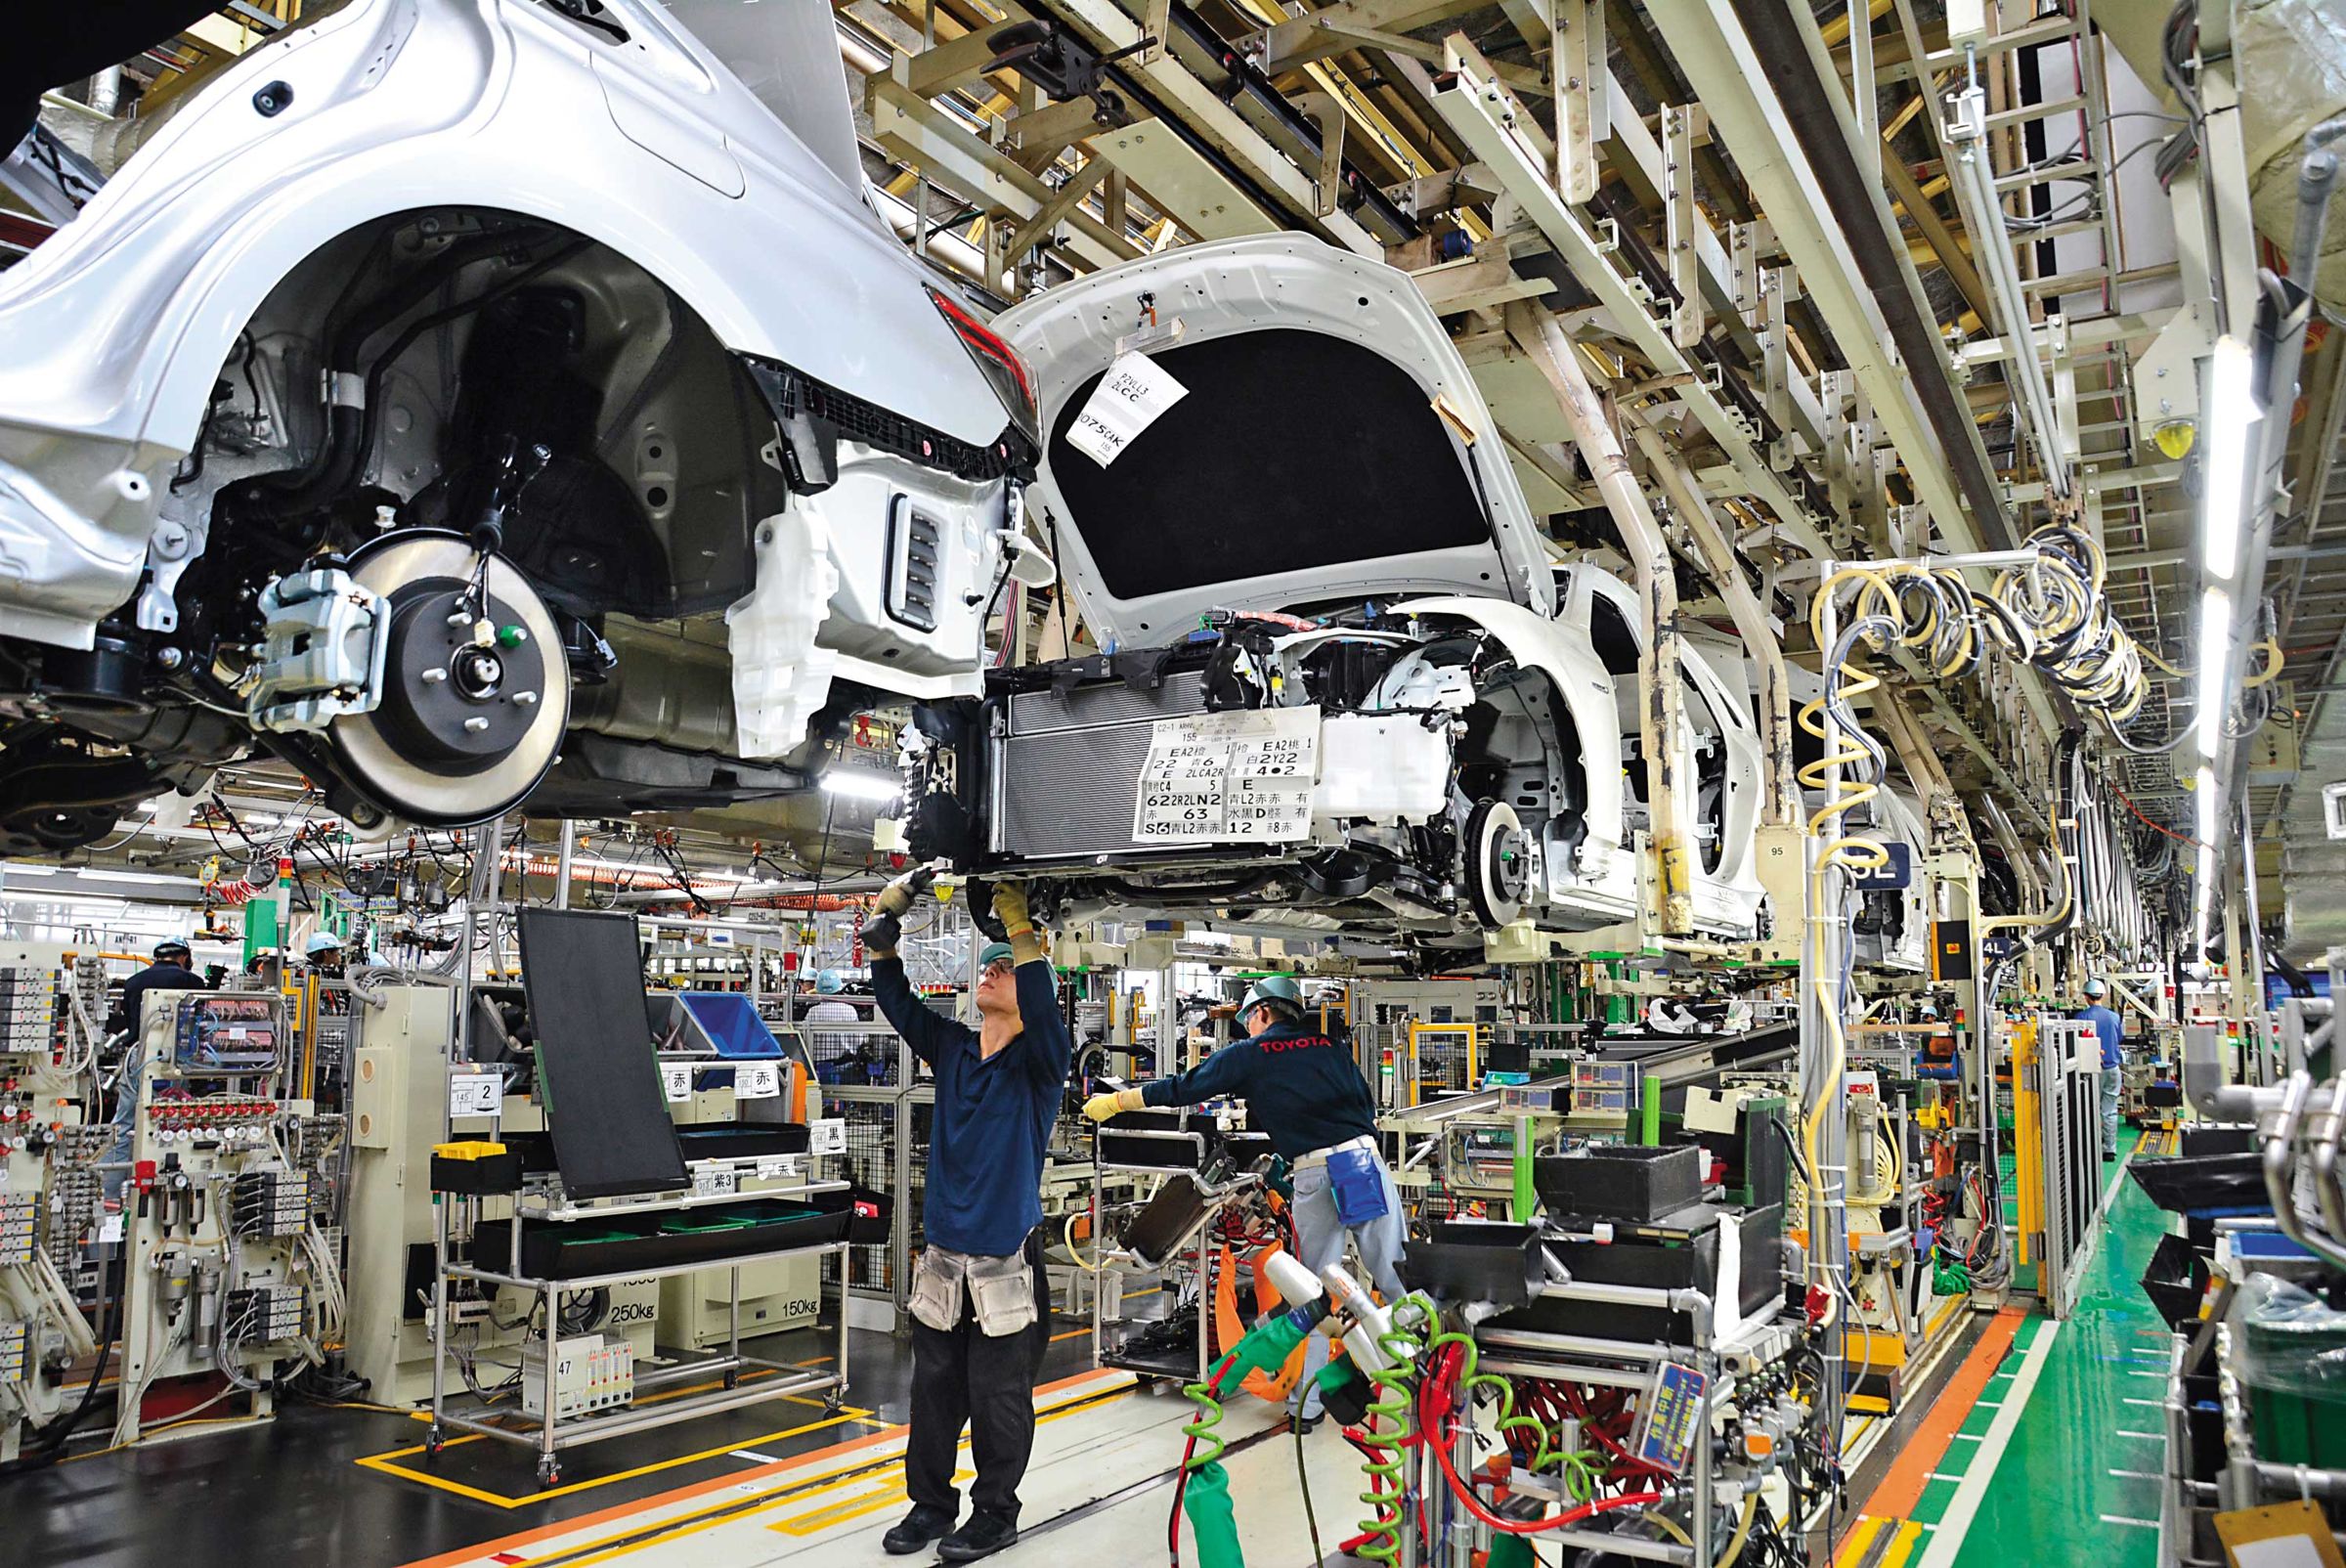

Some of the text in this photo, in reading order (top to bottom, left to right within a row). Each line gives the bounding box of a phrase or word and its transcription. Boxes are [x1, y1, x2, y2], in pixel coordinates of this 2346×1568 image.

[1183, 733, 1197, 742] 155
[1225, 745, 1230, 754] 1
[1153, 759, 1177, 768] 22
[1210, 779, 1216, 791] 5
[1243, 779, 1253, 790] E
[1296, 793, 1308, 804] 有
[1147, 808, 1208, 820] 赤 63
[1295, 806, 1307, 818] 有
[1229, 822, 1252, 834] 12
[1771, 847, 1783, 855] 95
[1983, 942, 2004, 954] 4L
[1259, 1036, 1332, 1054] TOYOTA
[673, 1073, 685, 1088] 赤
[756, 1071, 770, 1085] 赤
[456, 1093, 469, 1102] 145
[482, 1085, 491, 1099] 2
[828, 1126, 840, 1141] 黒
[611, 1303, 655, 1324] 250kg
[782, 1299, 817, 1318] 150kg
[558, 1360, 572, 1375] 47
